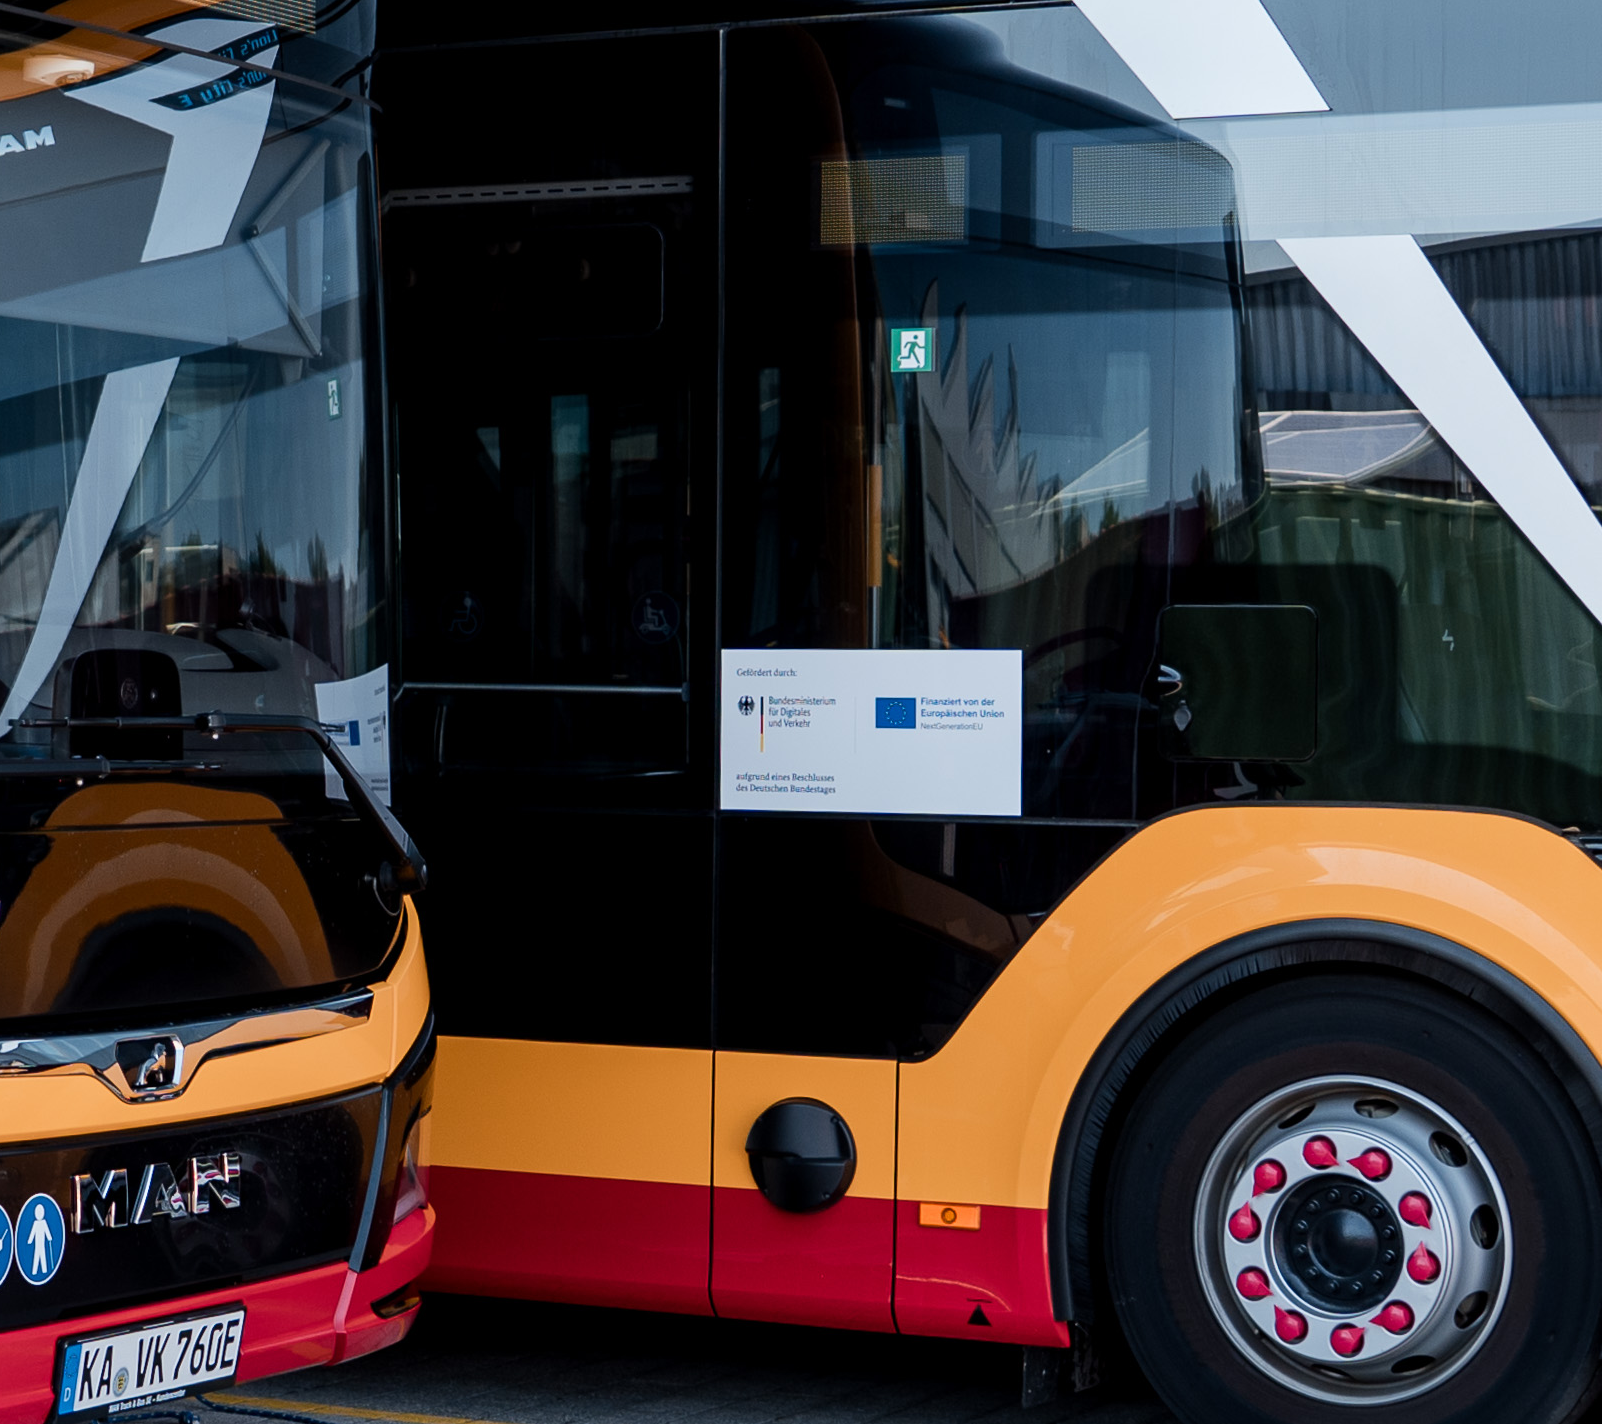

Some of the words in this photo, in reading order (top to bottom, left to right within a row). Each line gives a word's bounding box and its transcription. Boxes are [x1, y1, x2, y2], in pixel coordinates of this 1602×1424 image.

[736, 668, 772, 677] Gefördert
[774, 668, 797, 677] durch:
[768, 696, 836, 706] Bundesministerium
[920, 697, 961, 706] Finanziert
[963, 698, 979, 706] von
[981, 697, 995, 706] der
[768, 707, 779, 716] für
[780, 707, 811, 718] Digitales
[920, 709, 978, 719] Europäischen
[979, 709, 1005, 718] Union
[768, 719, 782, 728] und
[783, 719, 811, 728] Verkehr
[920, 722, 983, 731] NextGenerationEU
[736, 772, 770, 782] aufgrund
[771, 773, 790, 781] eines
[792, 772, 835, 782] Beschlusses
[736, 783, 748, 792] des
[749, 783, 788, 793] Deutschen
[790, 785, 836, 795] Bundestages
[70, 1152, 241, 1234] MAN
[78, 1345, 114, 1402] KA
[135, 1332, 171, 1389] VK
[173, 1318, 241, 1380] 760E
[64, 1387, 71, 1402] D
